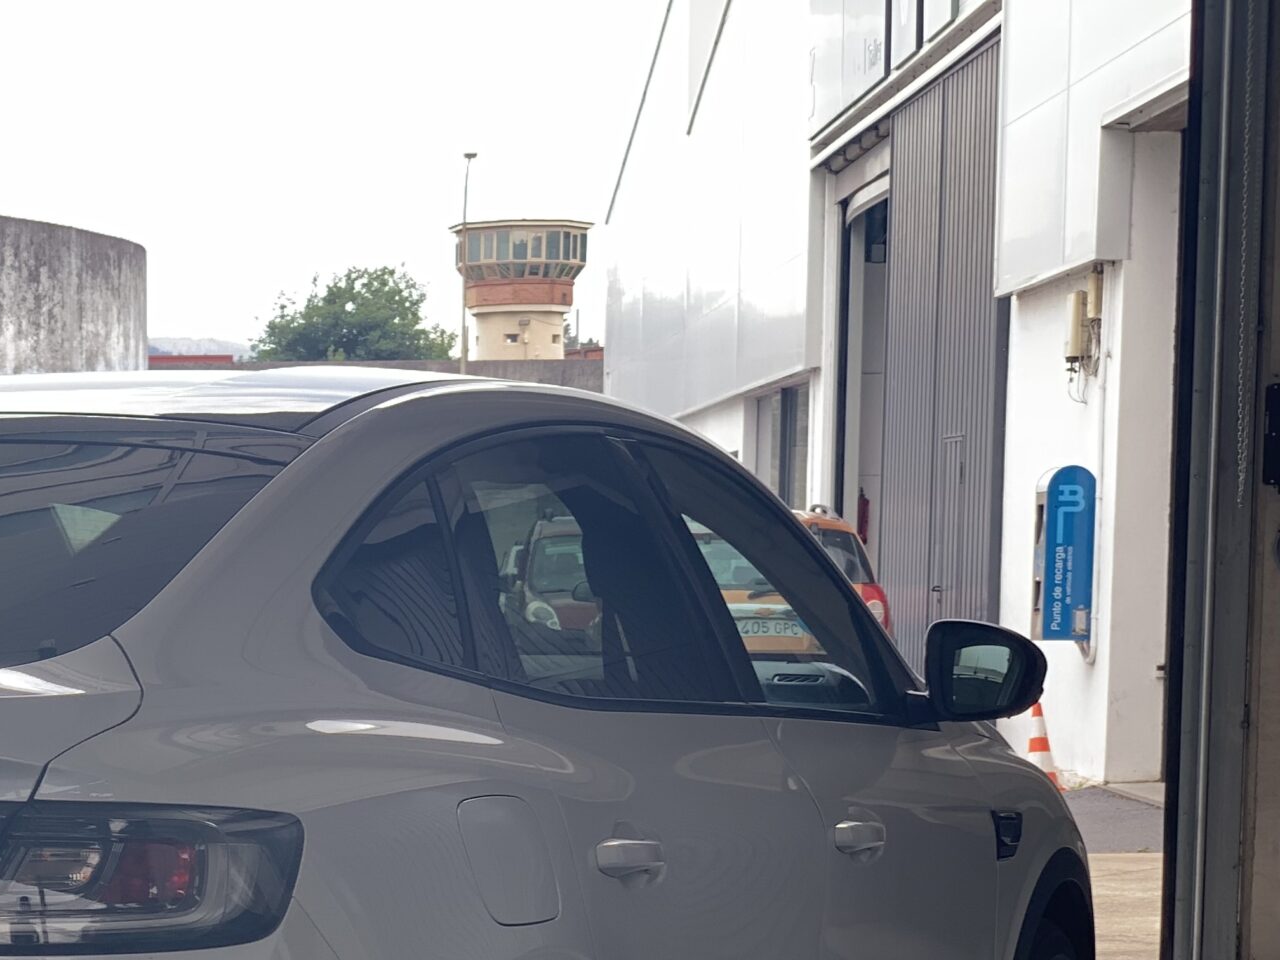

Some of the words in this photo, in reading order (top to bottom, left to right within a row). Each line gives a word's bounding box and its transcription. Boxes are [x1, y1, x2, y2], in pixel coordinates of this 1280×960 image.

[1055, 546, 1065, 584] recarga
[1053, 587, 1062, 599] de
[1051, 601, 1062, 631] Punto
